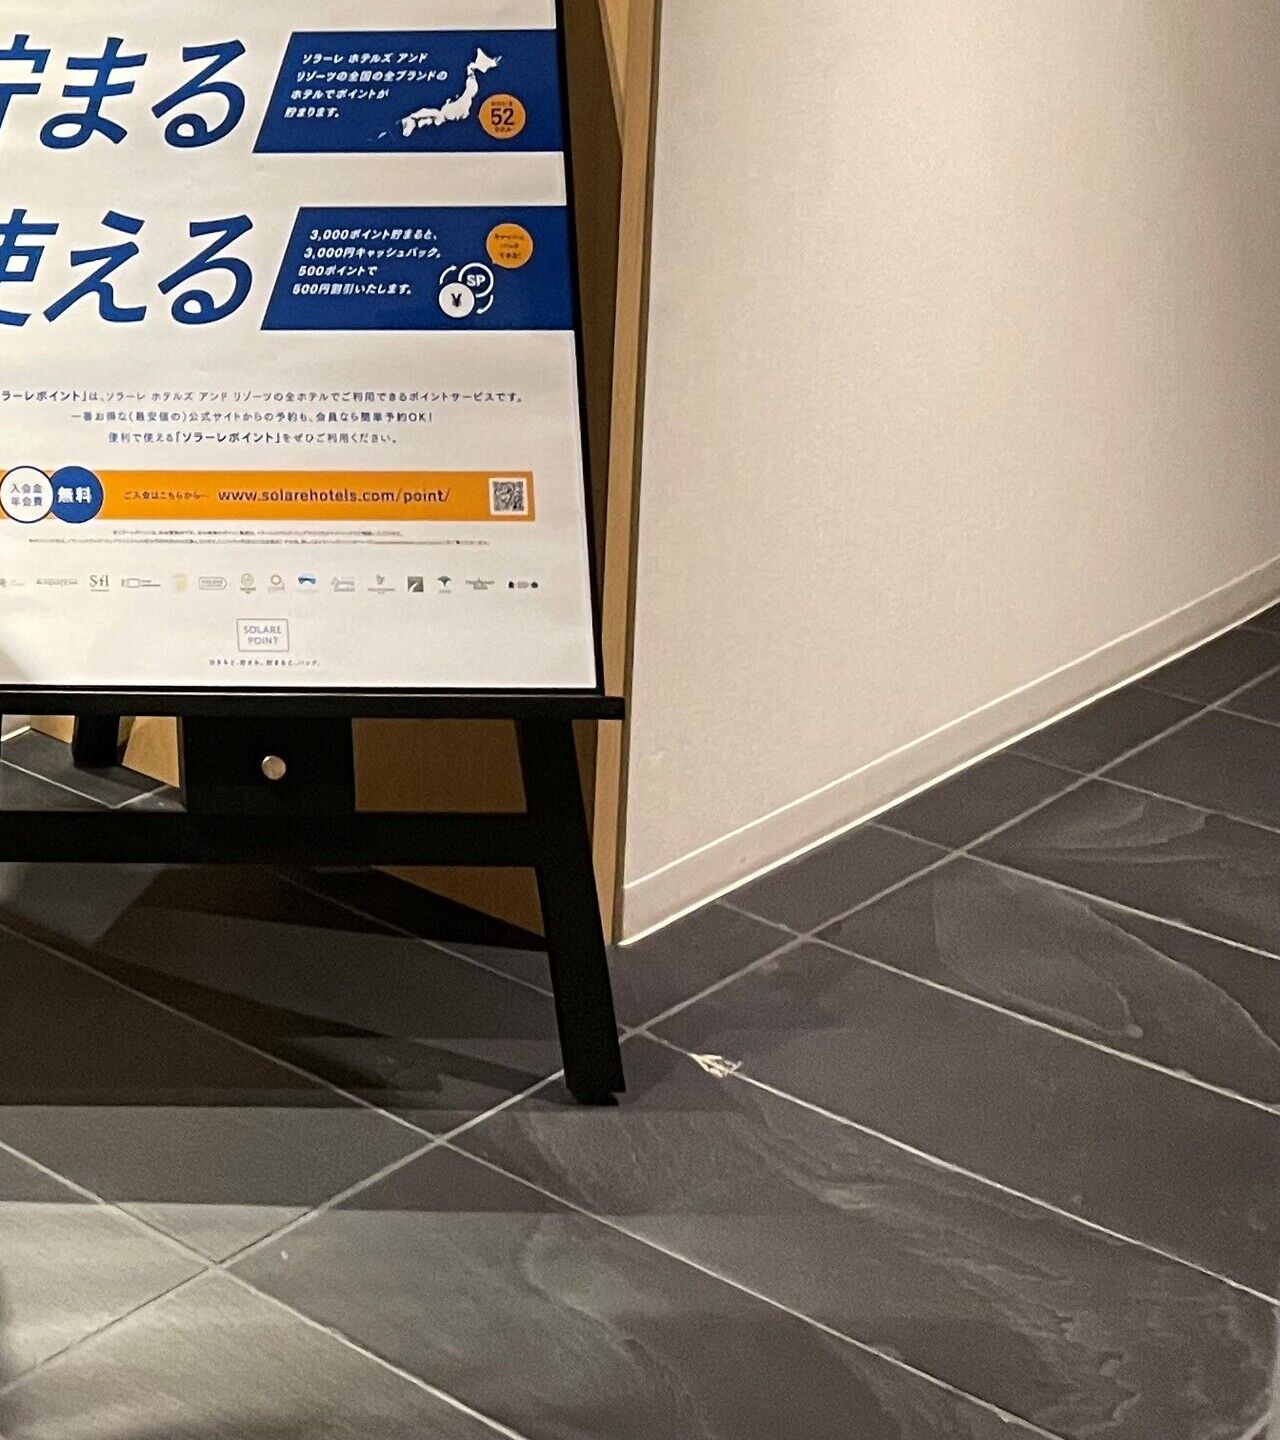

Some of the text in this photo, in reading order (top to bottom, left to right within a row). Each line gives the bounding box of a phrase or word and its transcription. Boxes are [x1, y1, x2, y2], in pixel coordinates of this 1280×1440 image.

[302, 53, 343, 64] ソラーレ
[397, 52, 428, 64] アンド
[290, 88, 390, 101] ホテルでポイントが
[284, 106, 340, 119] 貯まります。
[490, 108, 515, 126] 52
[298, 265, 378, 277] 500ポイントで
[466, 274, 485, 287] SP
[292, 283, 412, 295] 500円割引いたします。
[151, 391, 192, 402] ホテルズ
[10, 483, 43, 494] 入会金
[57, 485, 93, 504] 無料
[10, 496, 43, 507] 年会費
[218, 486, 452, 505] www.solarehotels.com/point/
[243, 625, 282, 635] SOLARE
[248, 636, 279, 646] POINT
